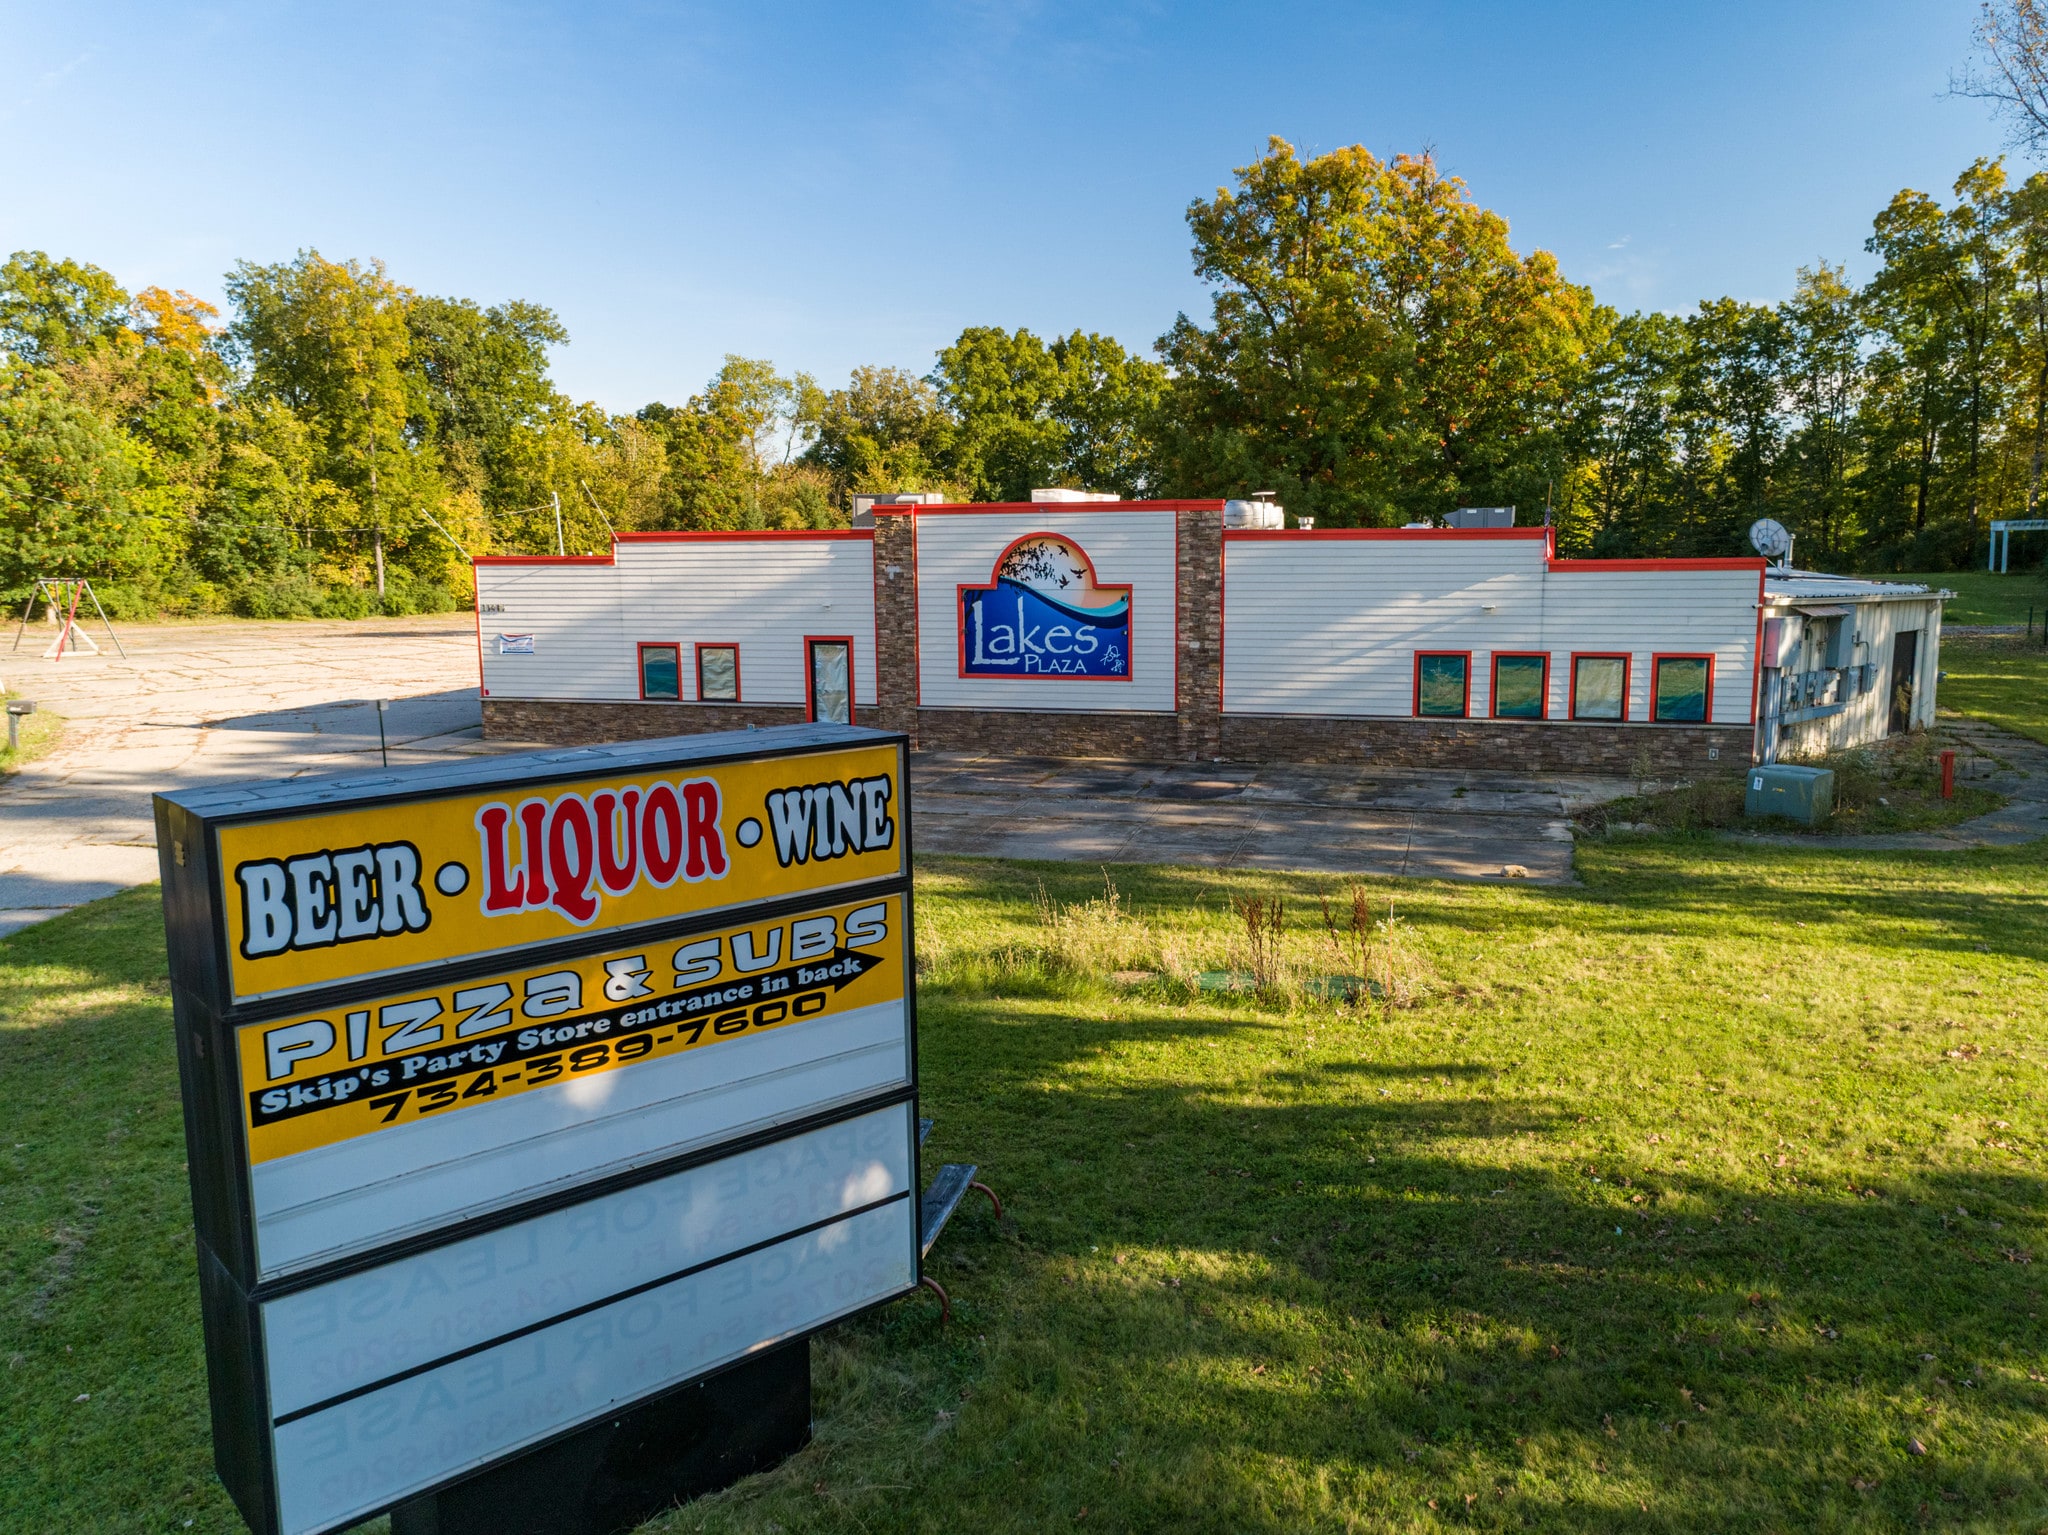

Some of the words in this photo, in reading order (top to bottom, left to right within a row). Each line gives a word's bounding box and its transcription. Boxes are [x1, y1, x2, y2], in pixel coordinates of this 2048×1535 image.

[972, 596, 1098, 665] Lakes
[1024, 654, 1087, 673] PLAZA
[236, 841, 432, 960] BEER
[475, 776, 731, 927] LIQUOR
[765, 773, 895, 868] WINE
[603, 955, 655, 1002] &
[672, 902, 887, 989] SUBS
[260, 1068, 389, 1114] Skip's
[401, 1041, 507, 1080] Party
[517, 1019, 611, 1051] Store
[620, 982, 753, 1027] entrance
[761, 975, 789, 995] in
[798, 957, 862, 986] back
[369, 991, 826, 1124] 734-389-7600
